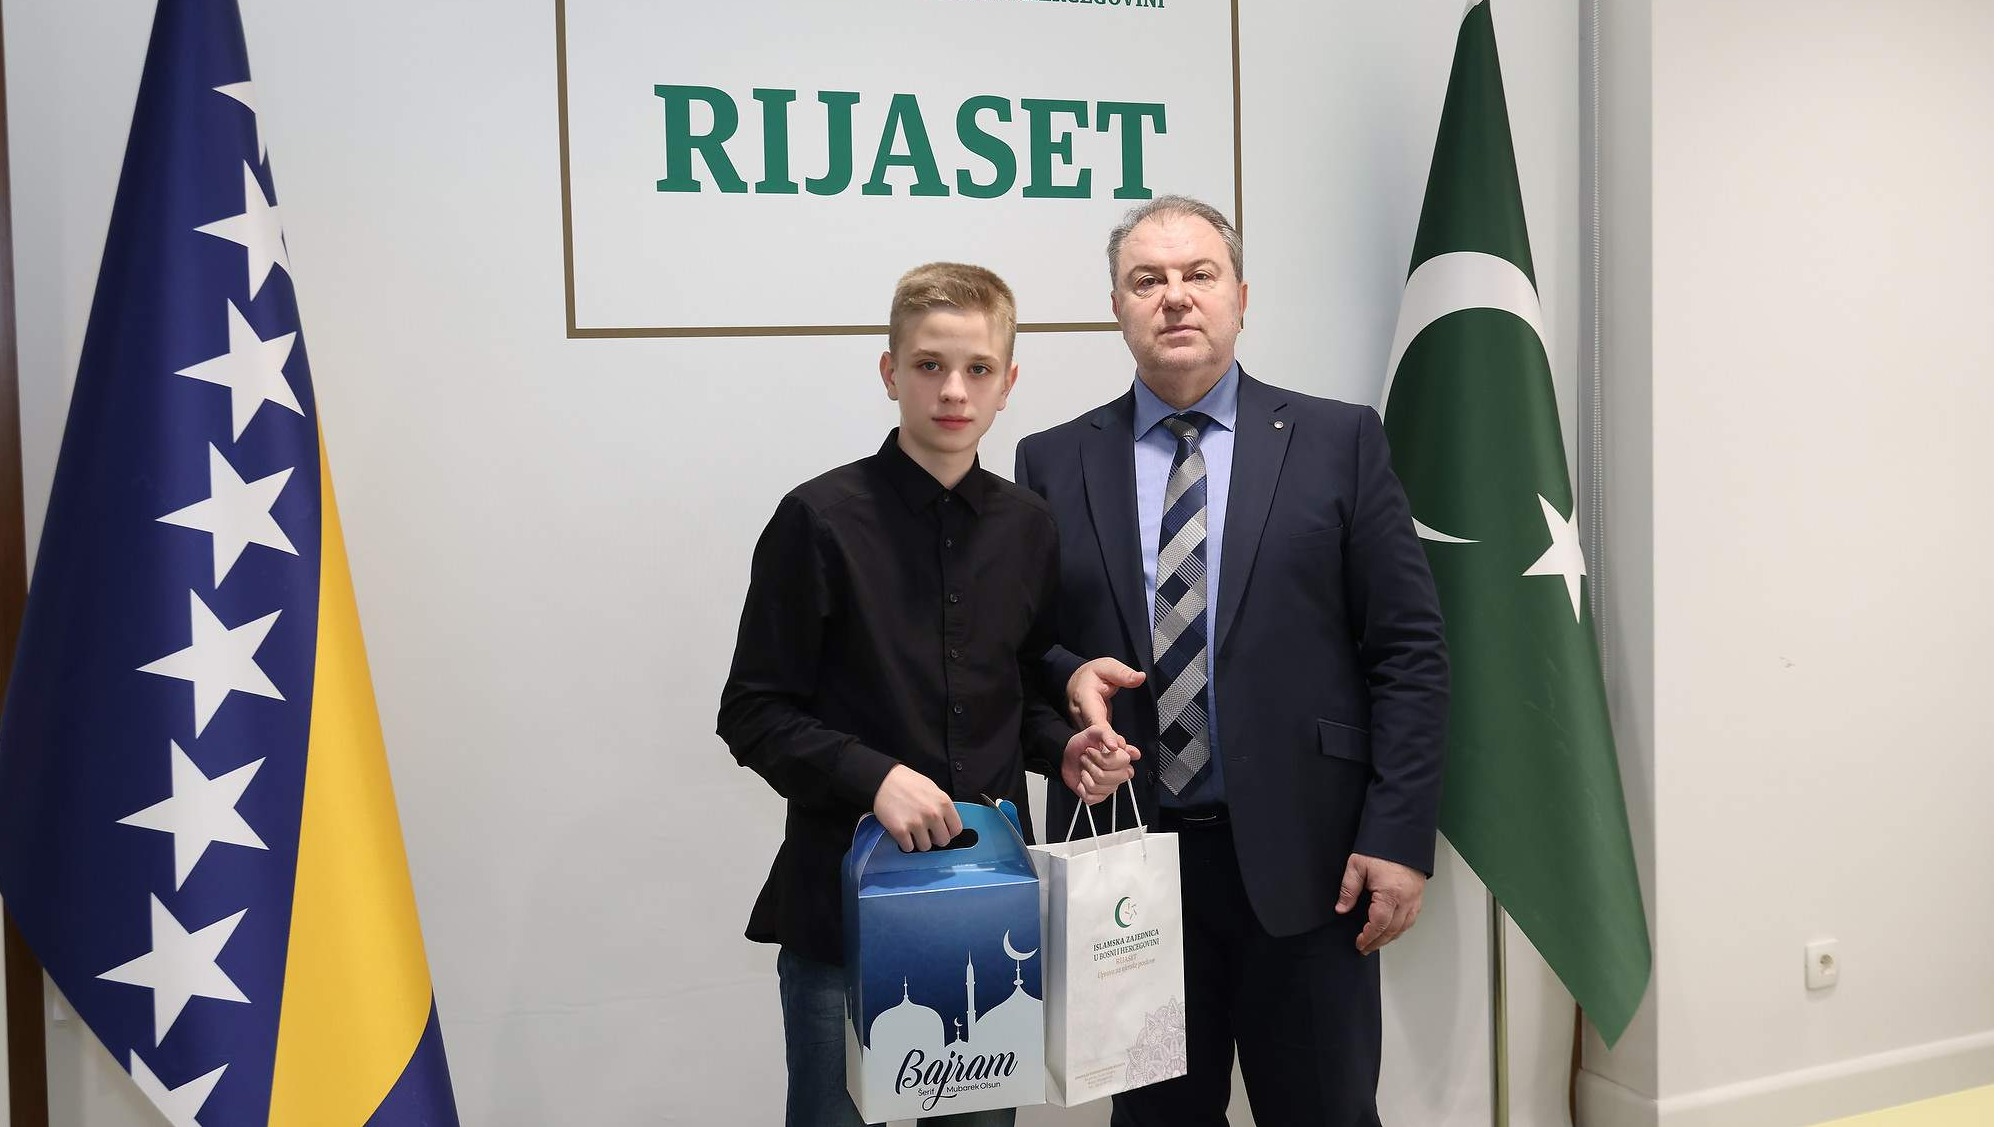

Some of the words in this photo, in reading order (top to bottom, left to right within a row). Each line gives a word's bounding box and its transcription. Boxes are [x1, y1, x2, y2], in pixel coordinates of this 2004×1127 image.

[654, 84, 1167, 199] RIJASET
[1093, 937, 1125, 952] ISLAMSKA
[1126, 928, 1160, 944] ZAJEDNICA
[1093, 954, 1099, 962] U
[1099, 949, 1117, 961] BOSNI
[1120, 937, 1160, 955] HERCEGOVINI
[895, 1049, 1018, 1111] Bajram
[946, 1082, 979, 1093] Mubarek
[979, 1081, 1001, 1090] Olsun
